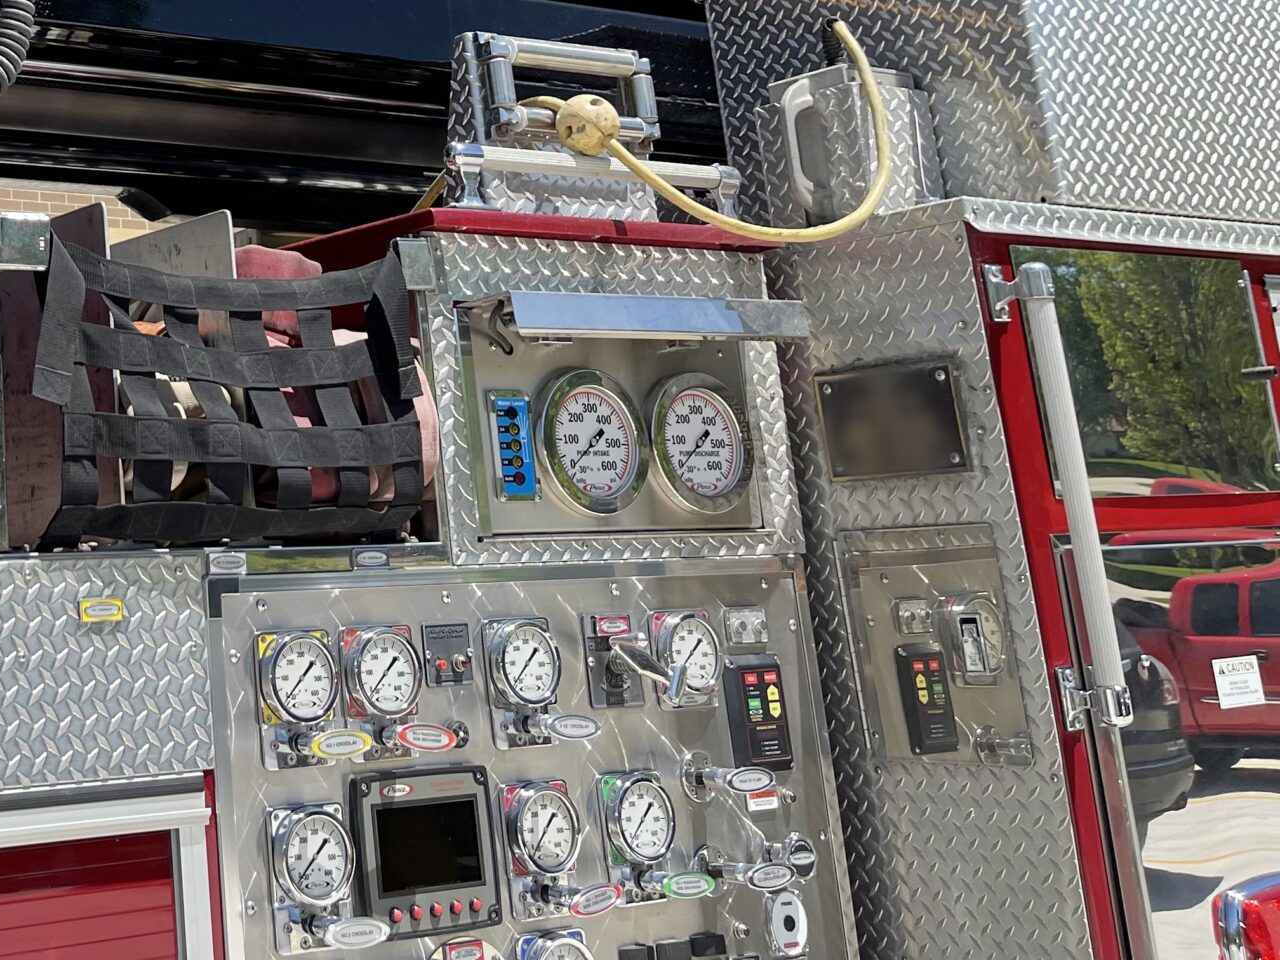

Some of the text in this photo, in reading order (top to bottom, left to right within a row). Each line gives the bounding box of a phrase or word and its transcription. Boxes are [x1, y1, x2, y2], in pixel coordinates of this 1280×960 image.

[582, 403, 597, 413] 300
[688, 405, 702, 414] 300
[568, 413, 583, 422] 200
[596, 415, 611, 424] 400
[676, 415, 690, 424] 200
[702, 417, 716, 426] 400
[564, 434, 578, 444] 100
[606, 439, 620, 448] 500
[672, 435, 685, 444] 100
[711, 439, 725, 448] 500
[570, 459, 576, 469] 0
[602, 461, 617, 471] 600
[678, 459, 683, 468] 0
[707, 461, 722, 470] 600
[1227, 661, 1254, 673] CAUTION
